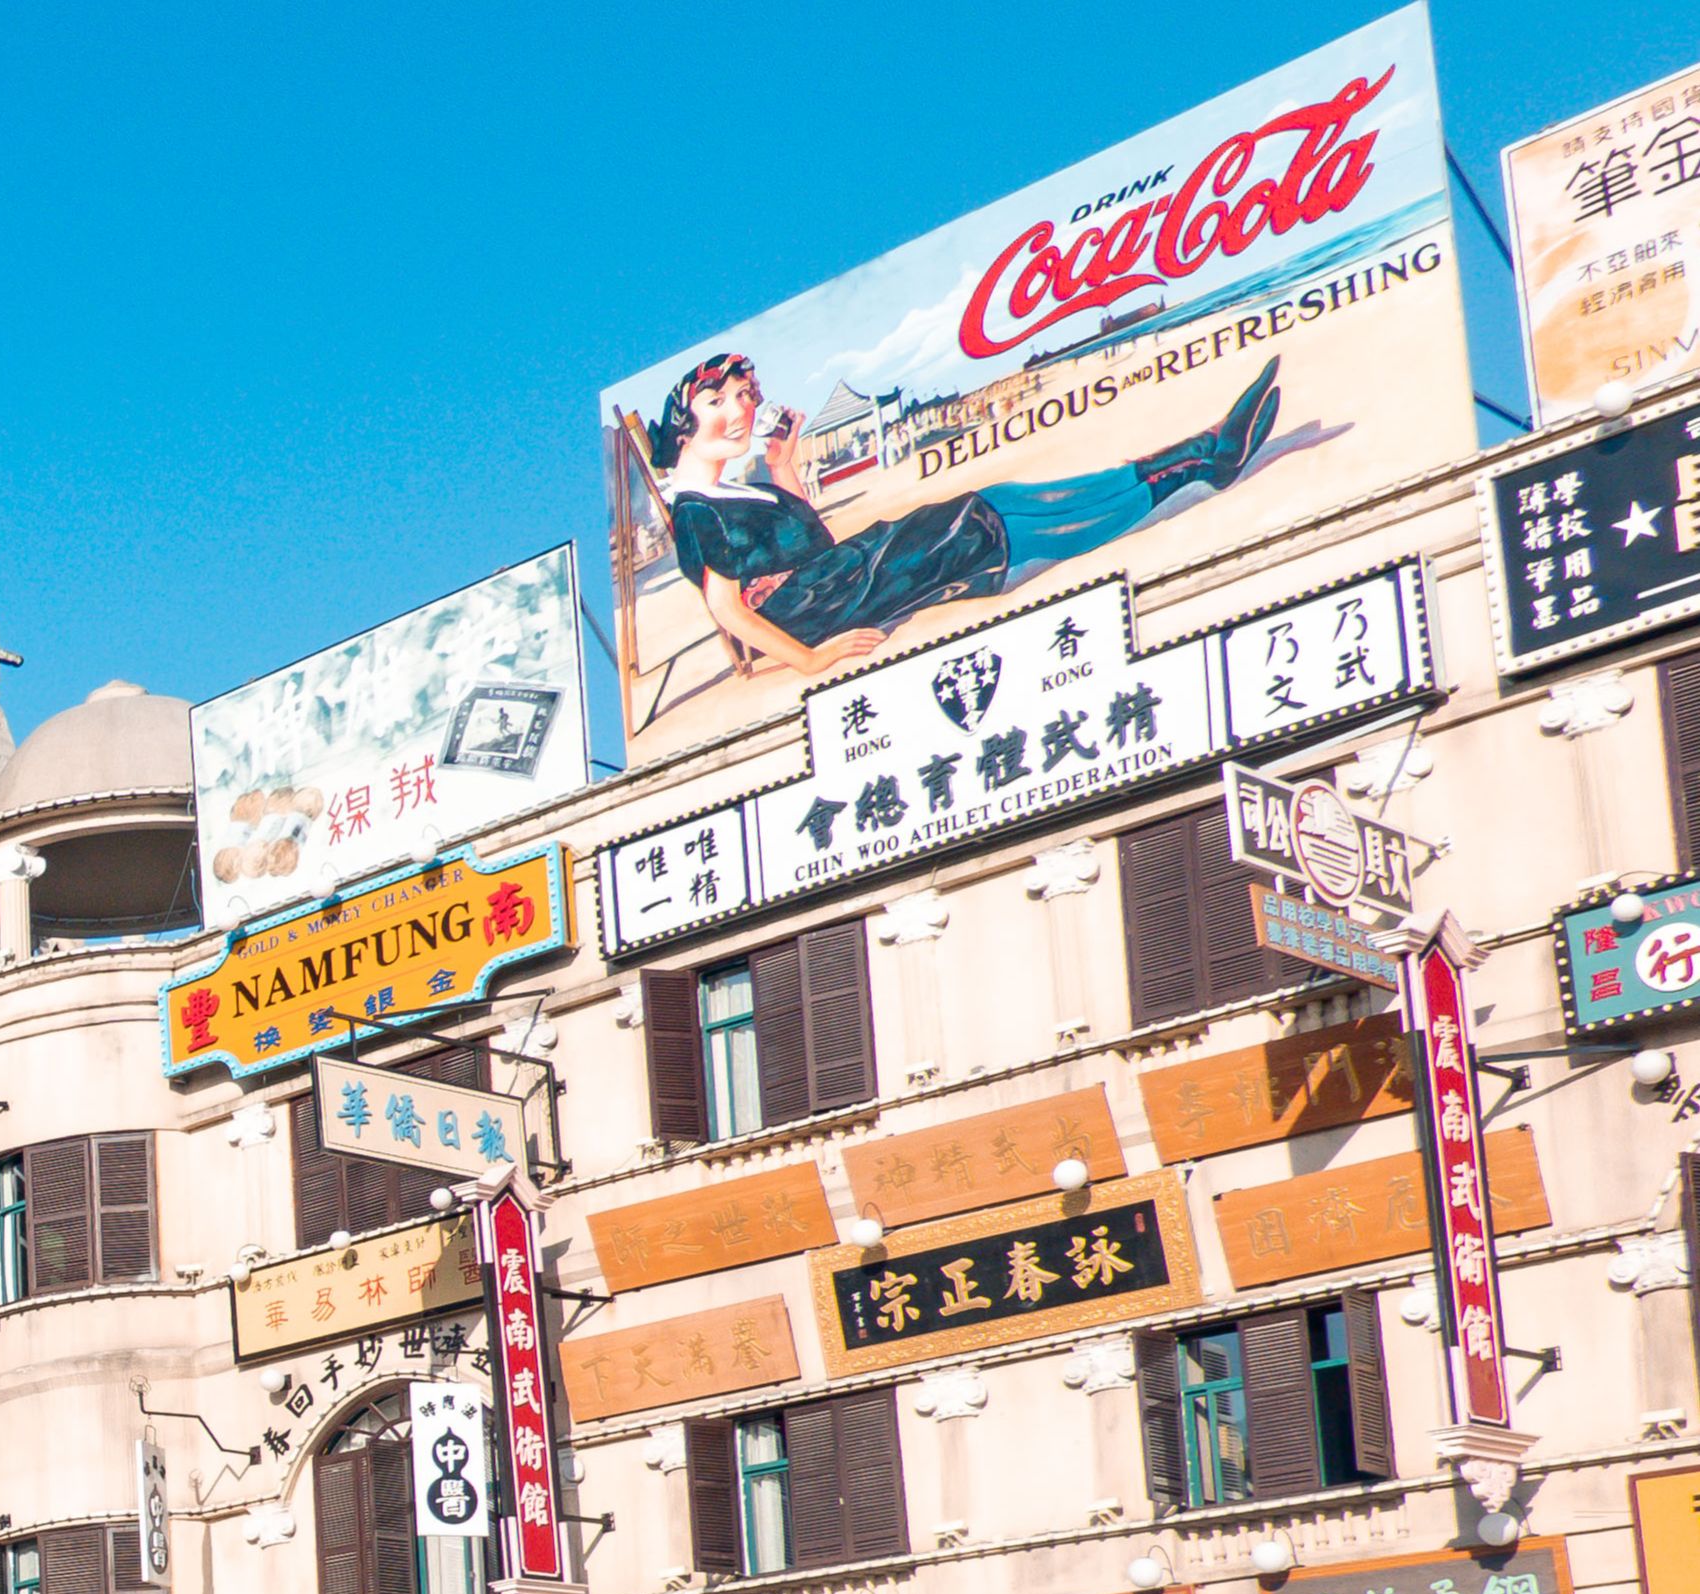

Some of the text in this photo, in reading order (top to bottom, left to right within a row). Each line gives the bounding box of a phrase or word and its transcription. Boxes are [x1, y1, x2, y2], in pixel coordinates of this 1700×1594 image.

[956, 63, 1396, 360] Coca-Cola
[1070, 164, 1175, 223] DRINK
[918, 242, 1444, 479] DELICIOUS AND REFRESHING
[845, 662, 1093, 763] HONG KONG
[795, 742, 1175, 882] CHIN WOO ATHLET CIFEDERATION
[230, 901, 477, 1018] NAMFUNG
[238, 869, 466, 960] GOLD & MONEY CHANGER
[337, 1081, 515, 1163] 華僑日報
[1431, 1015, 1495, 1363] 震南武術館
[500, 1247, 551, 1528] 震南武術館
[435, 1440, 473, 1519] 中醫
